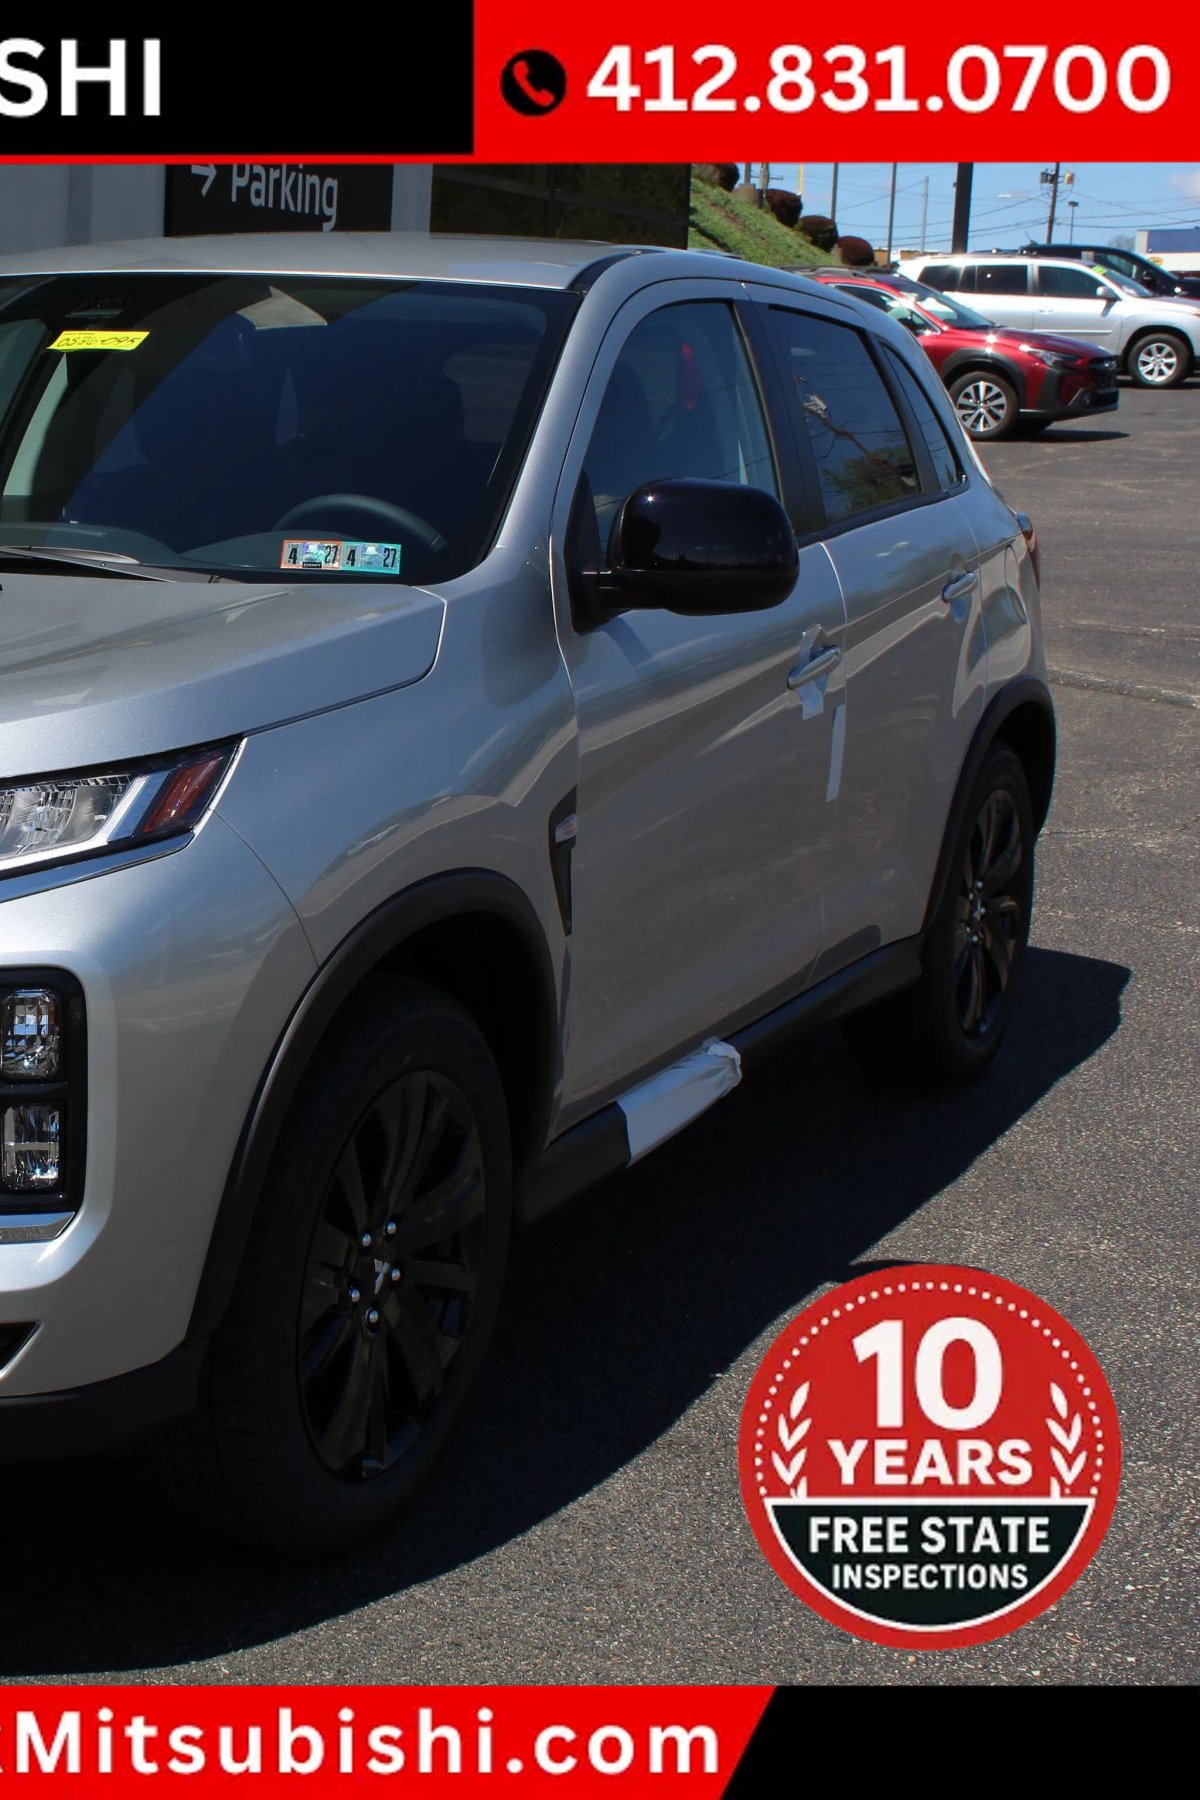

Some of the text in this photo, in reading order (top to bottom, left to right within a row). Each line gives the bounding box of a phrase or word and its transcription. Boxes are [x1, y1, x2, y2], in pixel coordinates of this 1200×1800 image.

[230, 164, 339, 232] Parking
[288, 545, 339, 565] 4 27
[346, 547, 397, 568] 4 27
